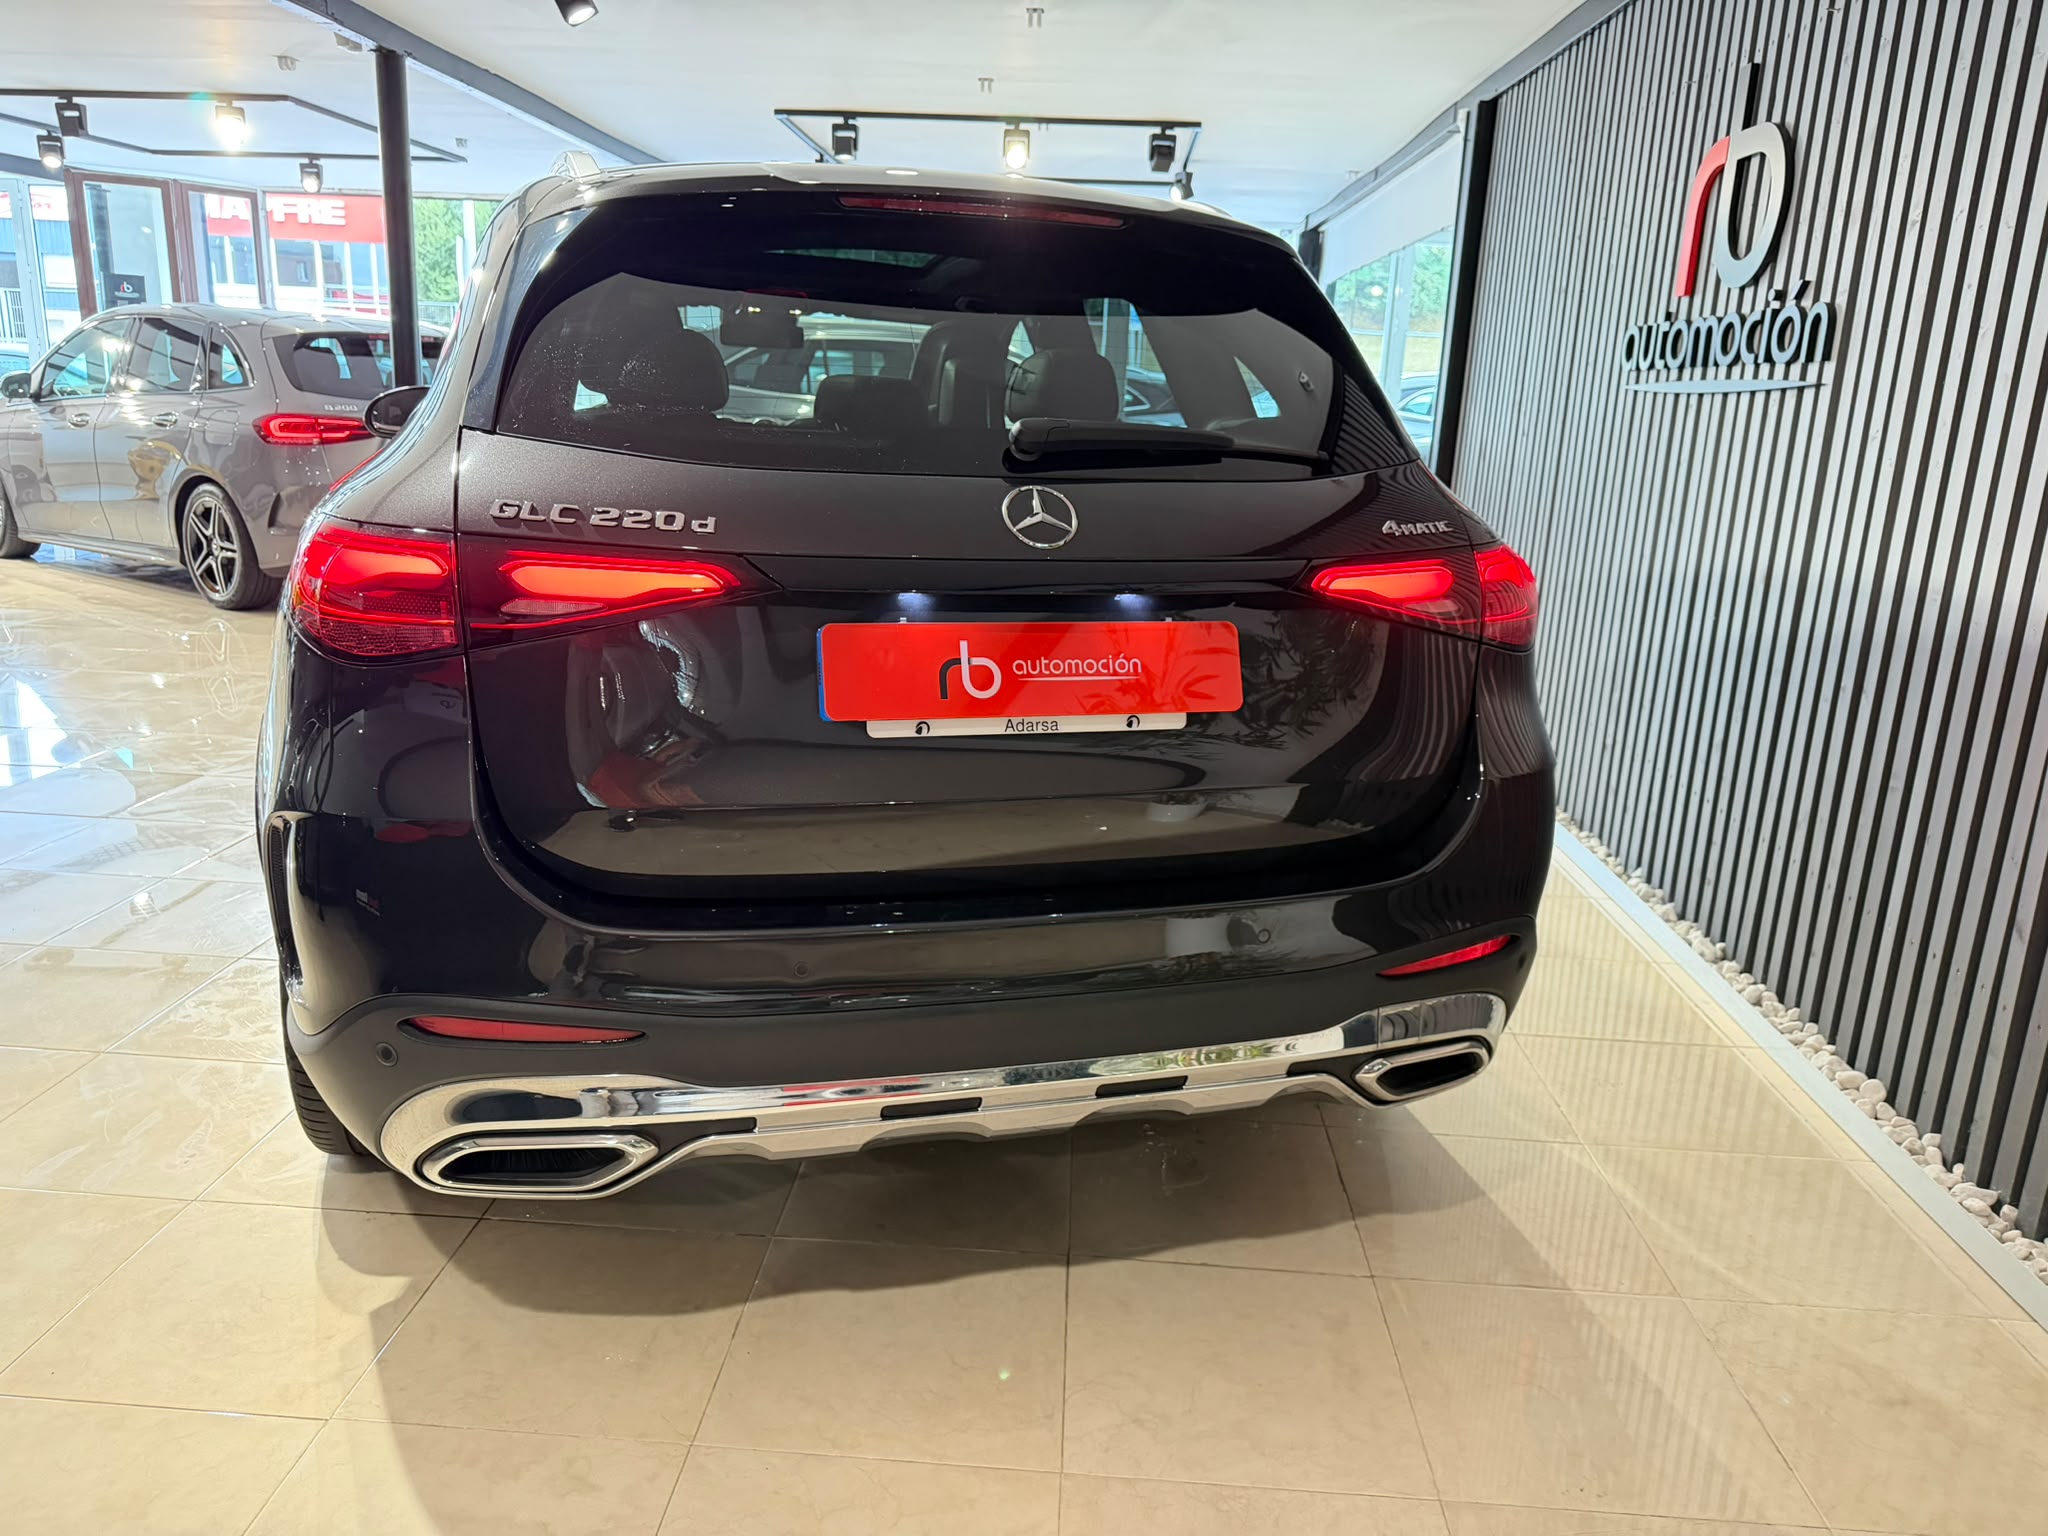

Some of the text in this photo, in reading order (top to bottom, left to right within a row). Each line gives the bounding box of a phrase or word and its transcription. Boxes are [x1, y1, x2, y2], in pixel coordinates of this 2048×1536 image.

[1622, 280, 1835, 371] automoción
[489, 499, 580, 524] GLC
[939, 640, 1142, 700] rb automoción
[1004, 718, 1059, 733] Adarsa
